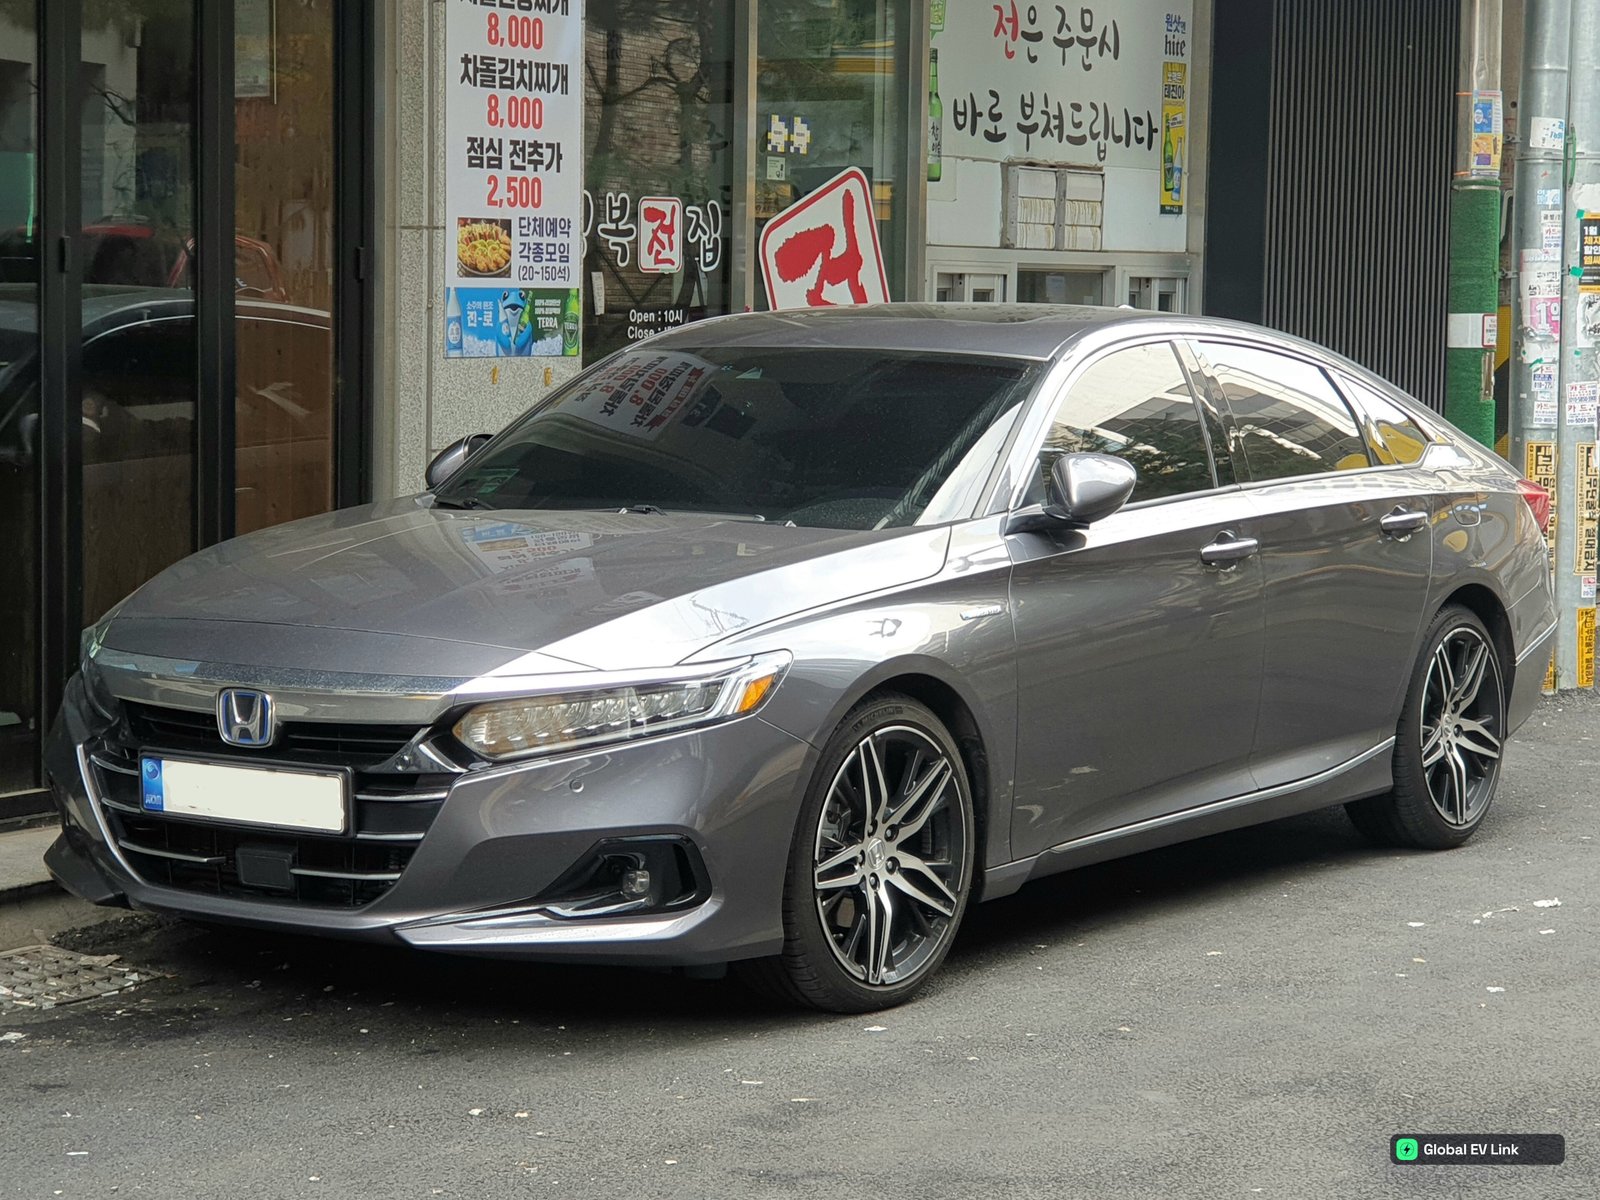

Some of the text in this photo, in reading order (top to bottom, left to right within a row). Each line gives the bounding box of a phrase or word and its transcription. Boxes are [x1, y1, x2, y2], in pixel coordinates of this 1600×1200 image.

[487, 12, 543, 49] 8,000
[993, 0, 1120, 71] 전은 주문시
[1164, 34, 1187, 57] hite
[460, 53, 569, 95] 차돌김치찌개
[1164, 84, 1185, 100] 테진아
[487, 94, 543, 129] 8,000
[953, 89, 1159, 162] 바로 부쳐드립니다
[467, 136, 563, 173] 점심 전추가
[487, 175, 542, 208] 2,500
[519, 216, 571, 239] 단체예약
[519, 242, 570, 263] 각종모임
[518, 265, 571, 282] (20~150석)
[537, 317, 558, 329] TERRA
[629, 309, 655, 323] Open
[664, 309, 683, 322] 10시
[628, 326, 655, 339] Close
